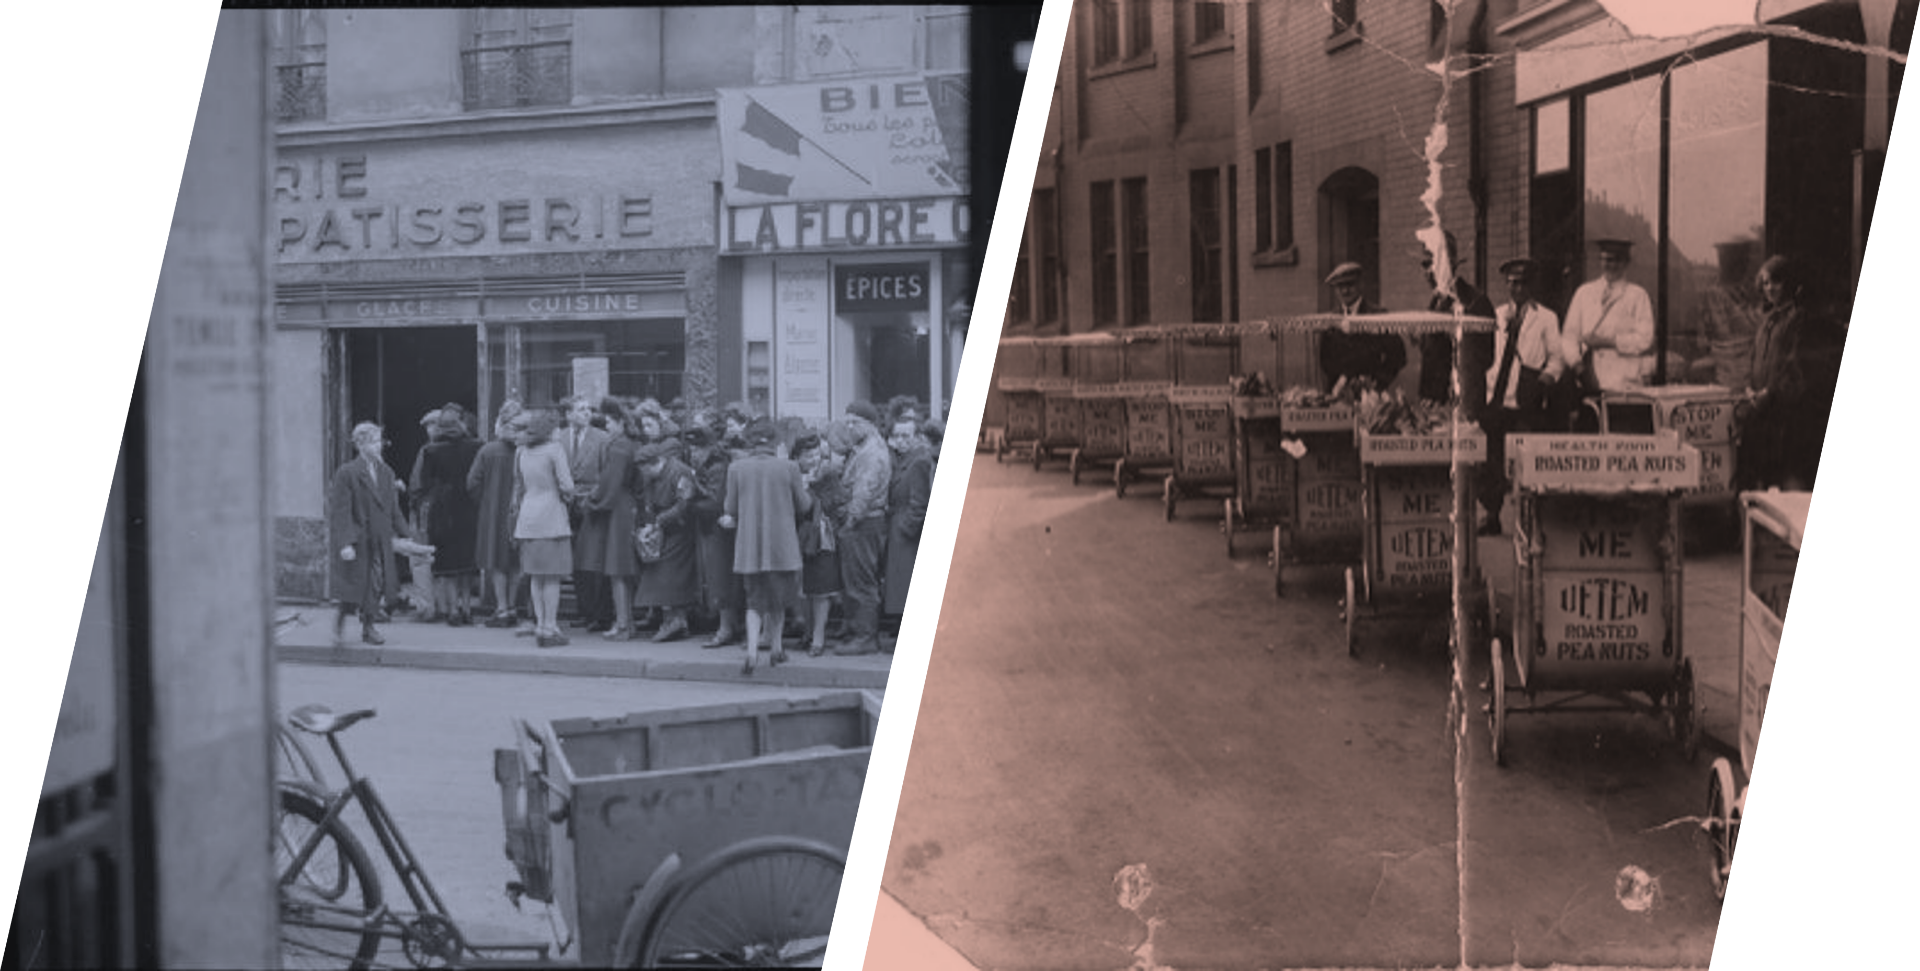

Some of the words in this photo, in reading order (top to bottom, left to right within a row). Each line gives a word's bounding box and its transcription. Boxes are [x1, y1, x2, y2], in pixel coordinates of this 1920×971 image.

[278, 194, 653, 254] PATISSERIE
[728, 204, 779, 251] LA
[796, 199, 935, 249] FLORE
[528, 294, 640, 314] CUISINE
[1686, 424, 1713, 440] ME
[1535, 455, 1601, 472] ROASTED
[1606, 455, 1639, 472] PEA
[1644, 455, 1687, 472] NUTS
[1403, 493, 1441, 514] ME
[1579, 530, 1633, 558] ME
[1564, 624, 1638, 640] ROASTED
